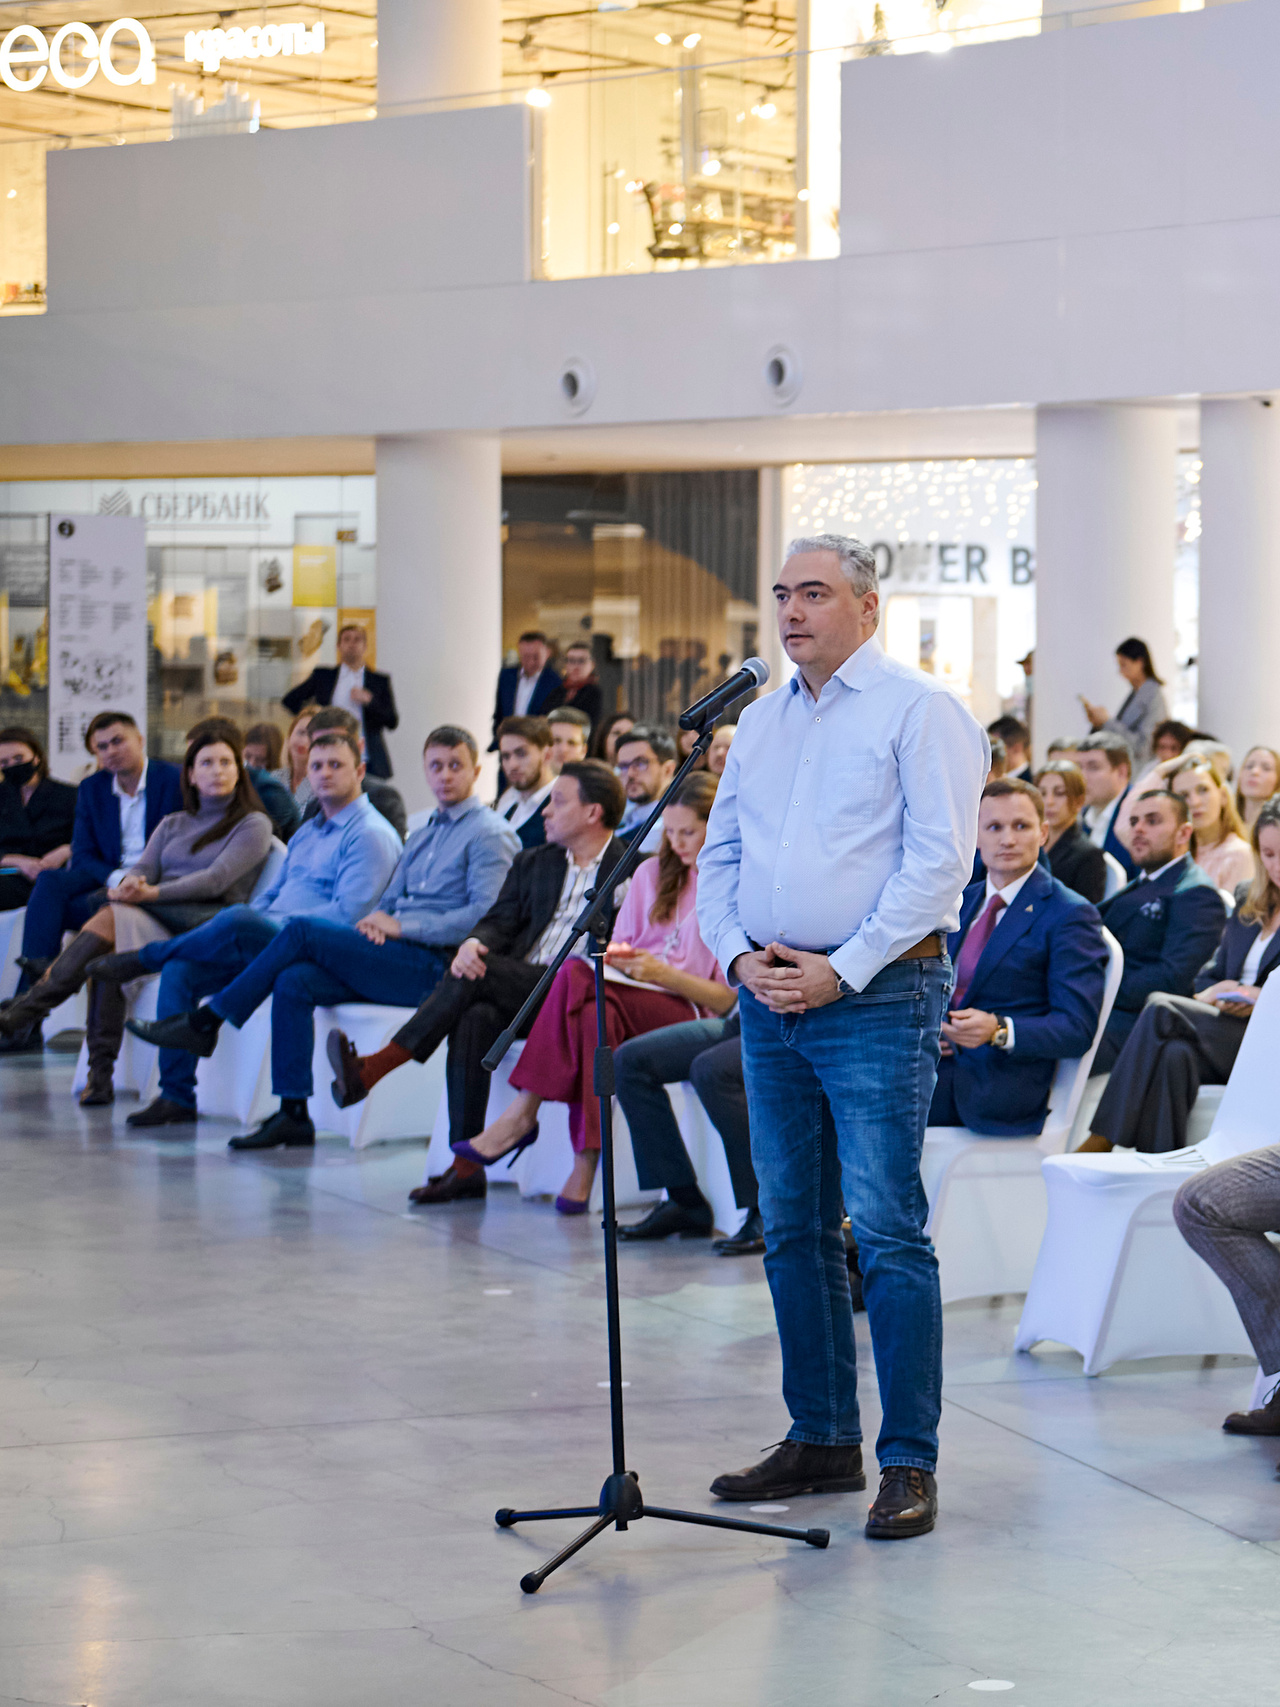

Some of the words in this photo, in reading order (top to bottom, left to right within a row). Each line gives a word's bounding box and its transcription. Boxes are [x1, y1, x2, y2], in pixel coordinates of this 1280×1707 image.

[184, 21, 325, 72] красоты
[140, 491, 270, 521] СБЕРБАНК
[868, 541, 987, 584] OWER
[1011, 546, 1036, 585] B
